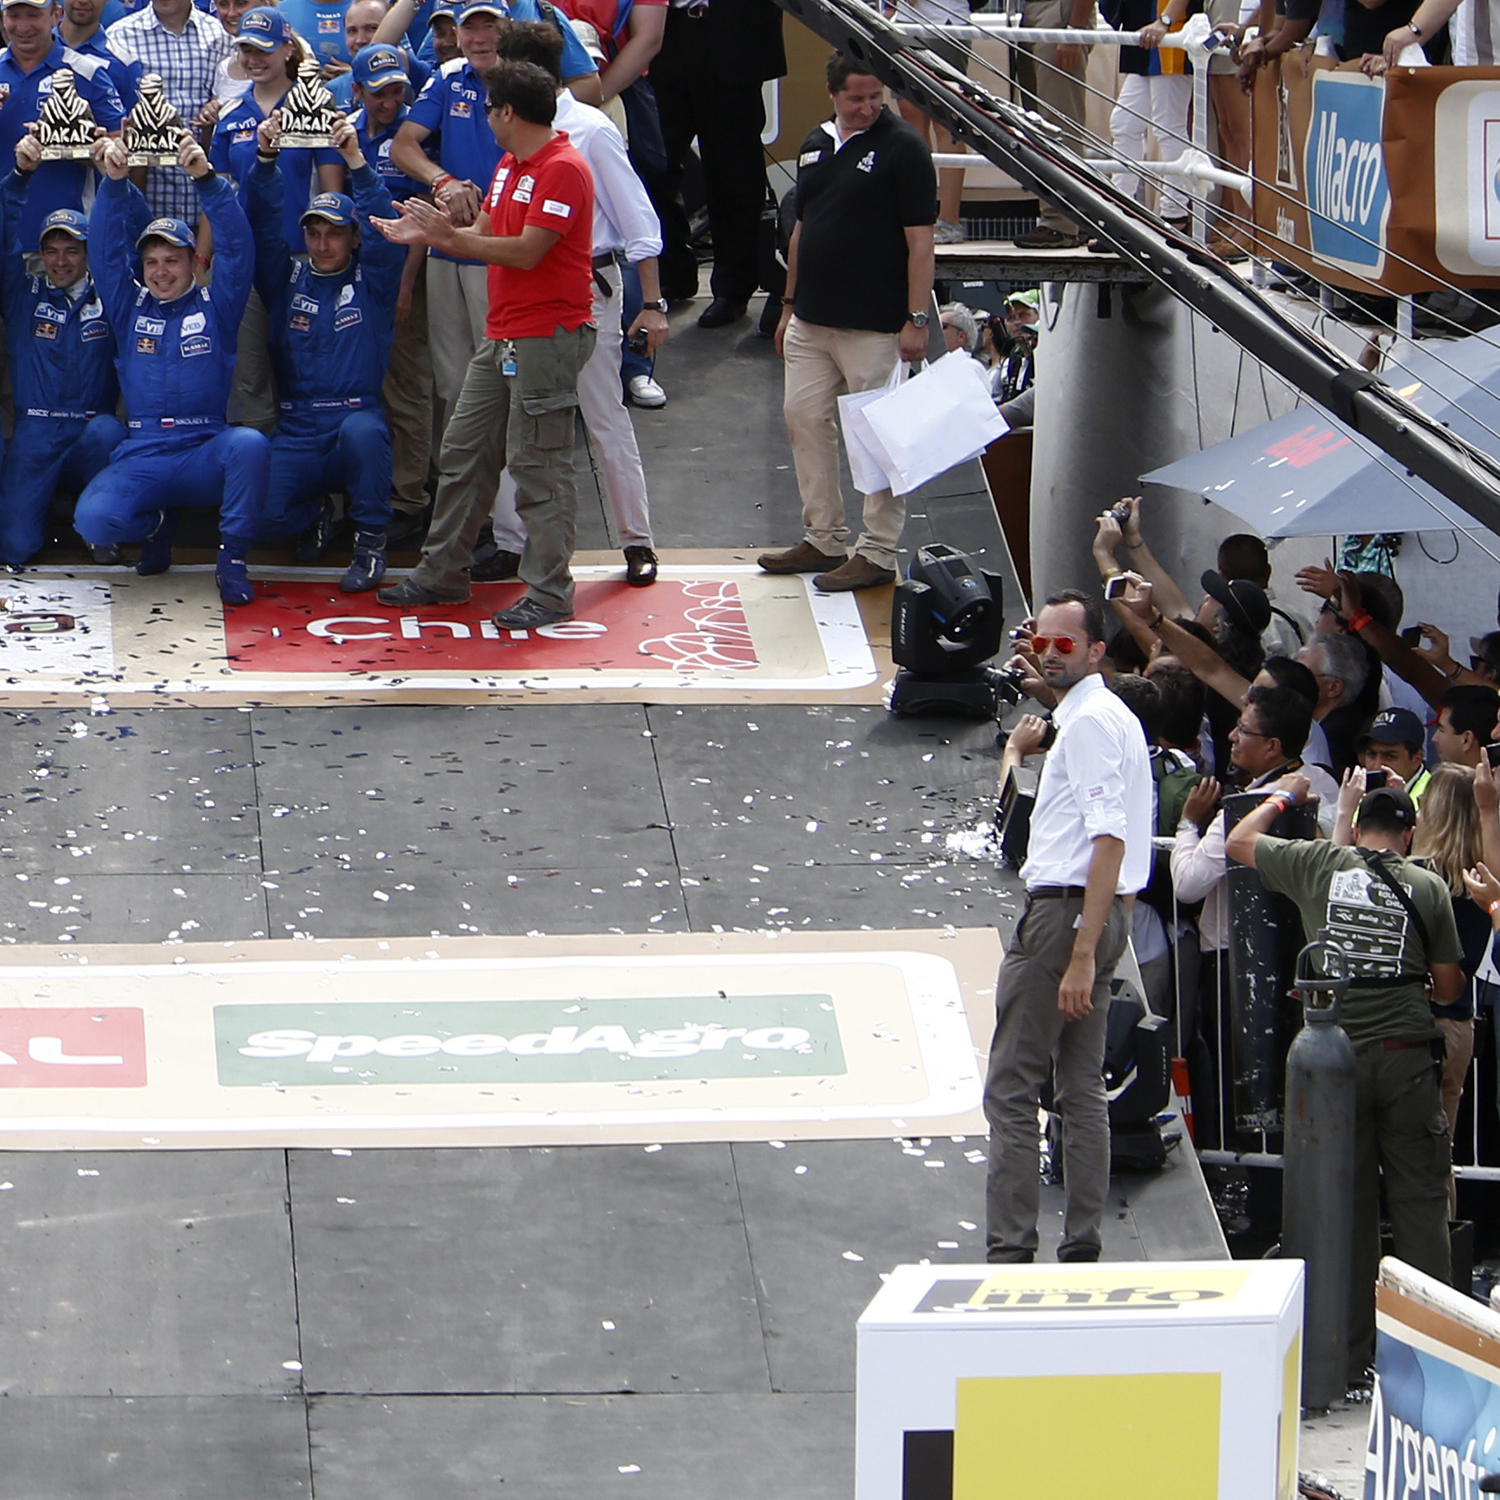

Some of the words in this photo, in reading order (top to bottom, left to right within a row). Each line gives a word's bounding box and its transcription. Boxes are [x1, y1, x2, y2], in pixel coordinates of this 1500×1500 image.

[462, 88, 477, 101] VTB
[40, 119, 95, 144] DAKAR
[238, 116, 257, 129] VTB
[282, 107, 333, 132] DAKAR
[127, 125, 181, 151] DAKAR
[1315, 110, 1381, 226] Macro
[183, 342, 210, 353] KAMAZ
[235, 1020, 812, 1064] SpeedAgro
